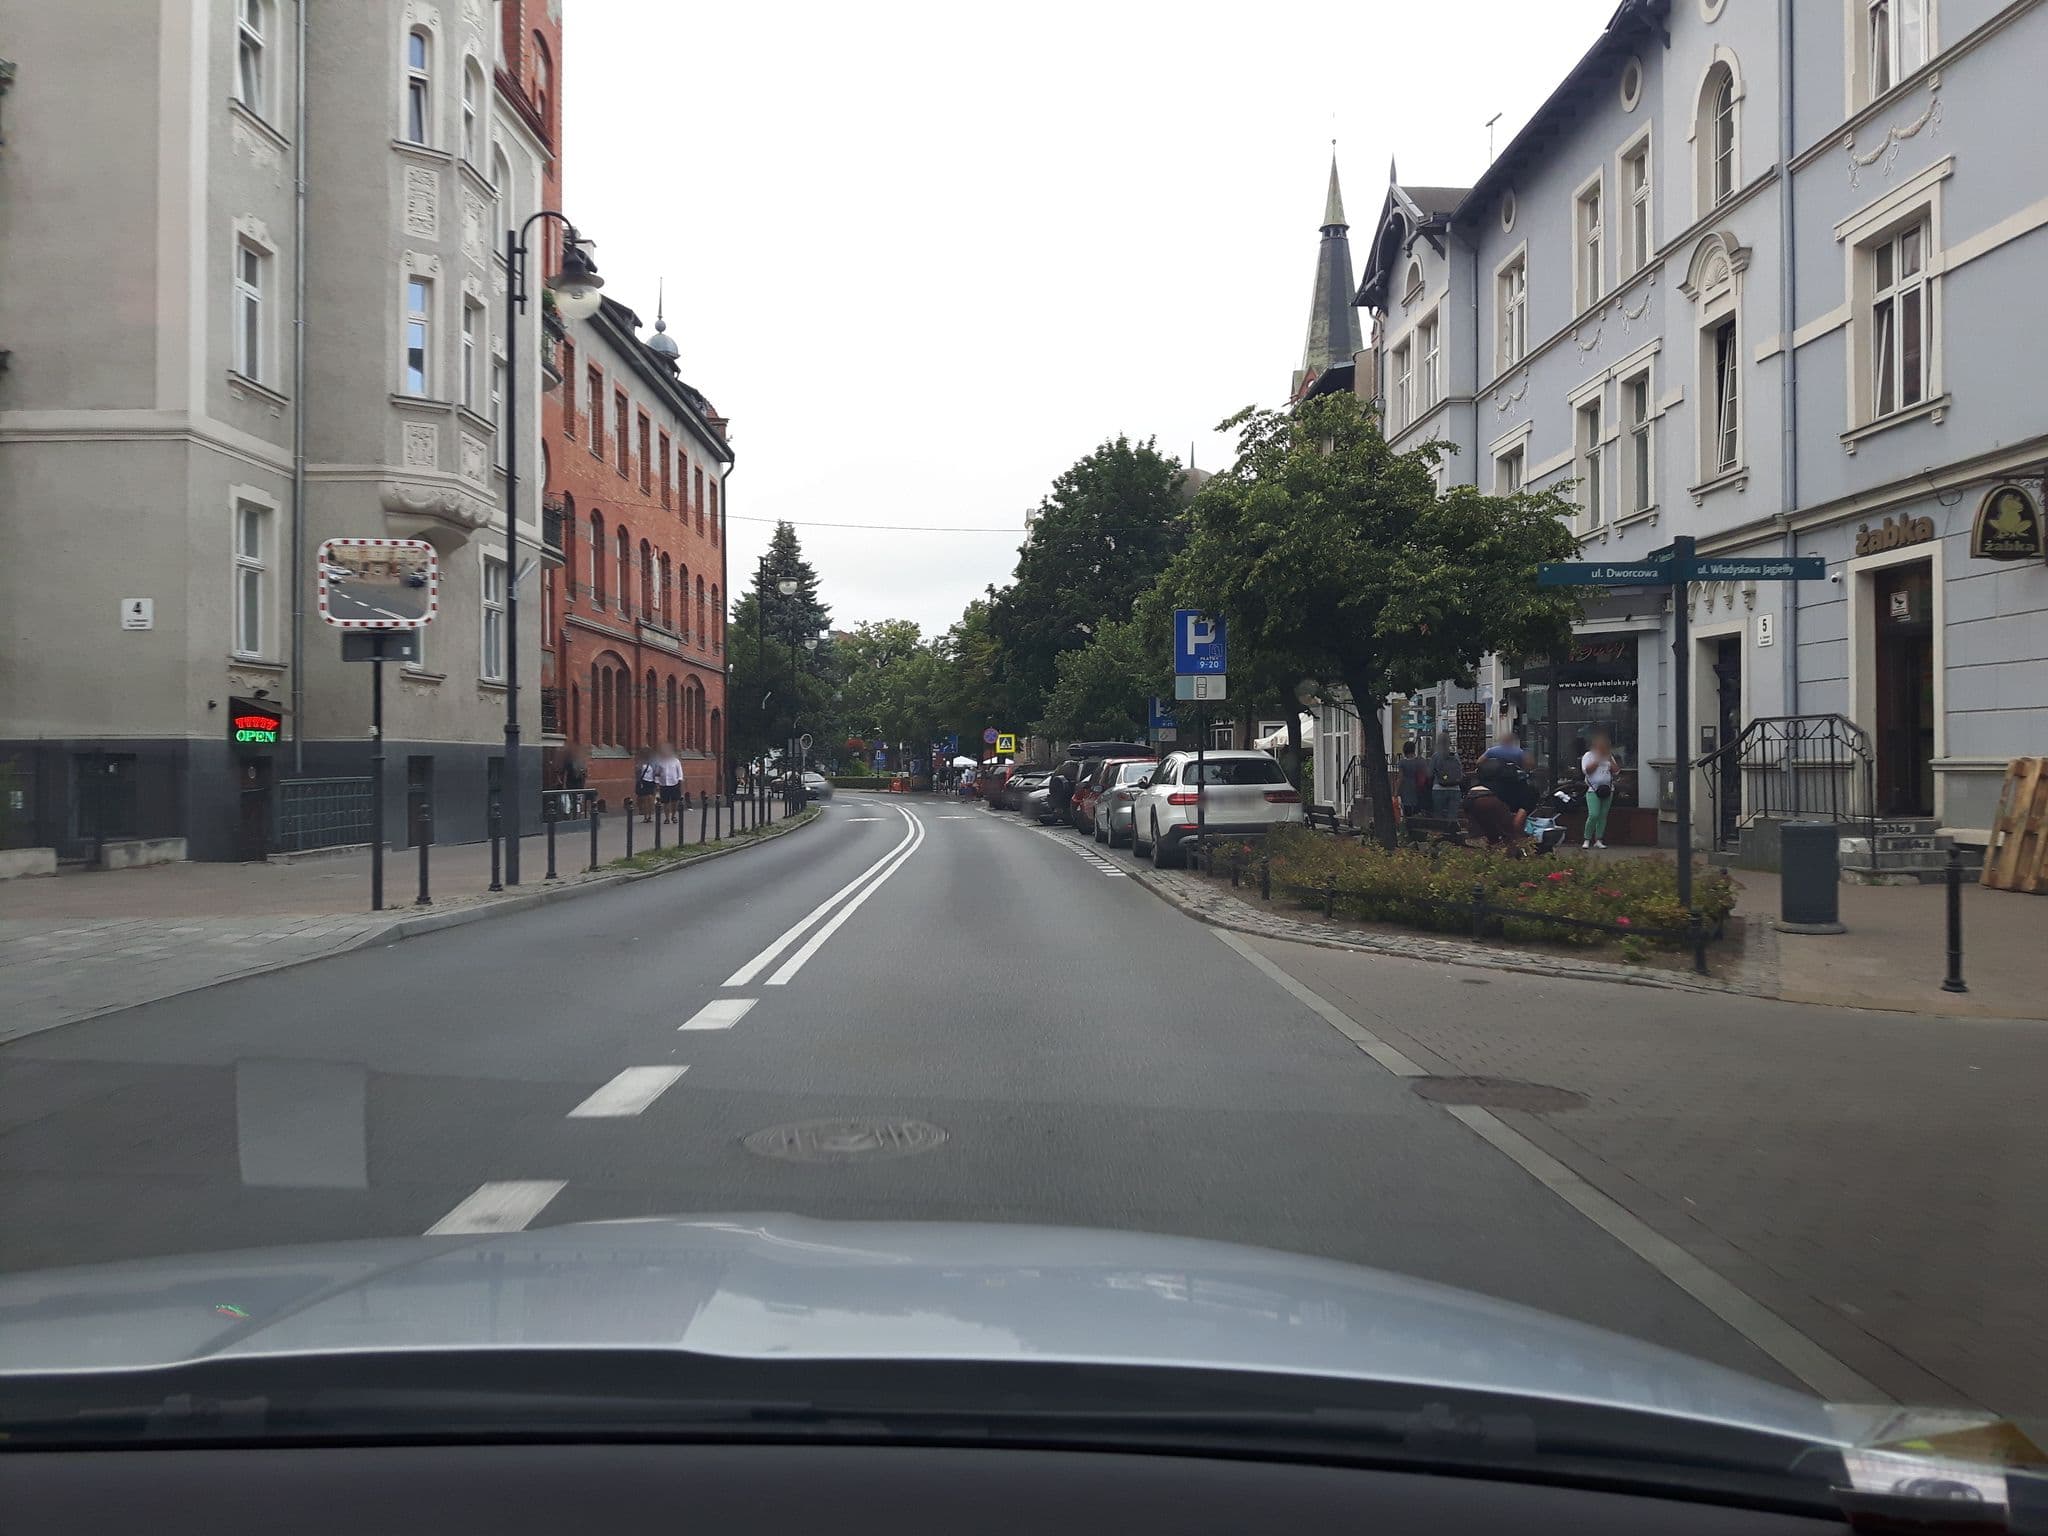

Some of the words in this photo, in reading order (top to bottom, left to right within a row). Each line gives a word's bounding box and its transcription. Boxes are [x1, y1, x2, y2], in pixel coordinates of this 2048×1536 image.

[1856, 512, 1935, 555] żabka
[1984, 539, 2036, 551] żabka
[1591, 568, 1604, 578] ul.
[1606, 568, 1659, 578] Dworcowa
[1697, 563, 1709, 574] ul.
[1710, 563, 1761, 576] Władysława
[132, 601, 142, 615] 4
[1762, 618, 1768, 632] 5
[1187, 615, 1216, 655] P
[1199, 660, 1219, 669] 9-20
[1571, 693, 1629, 706] Wyprzedaż
[236, 730, 277, 742] OPEN
